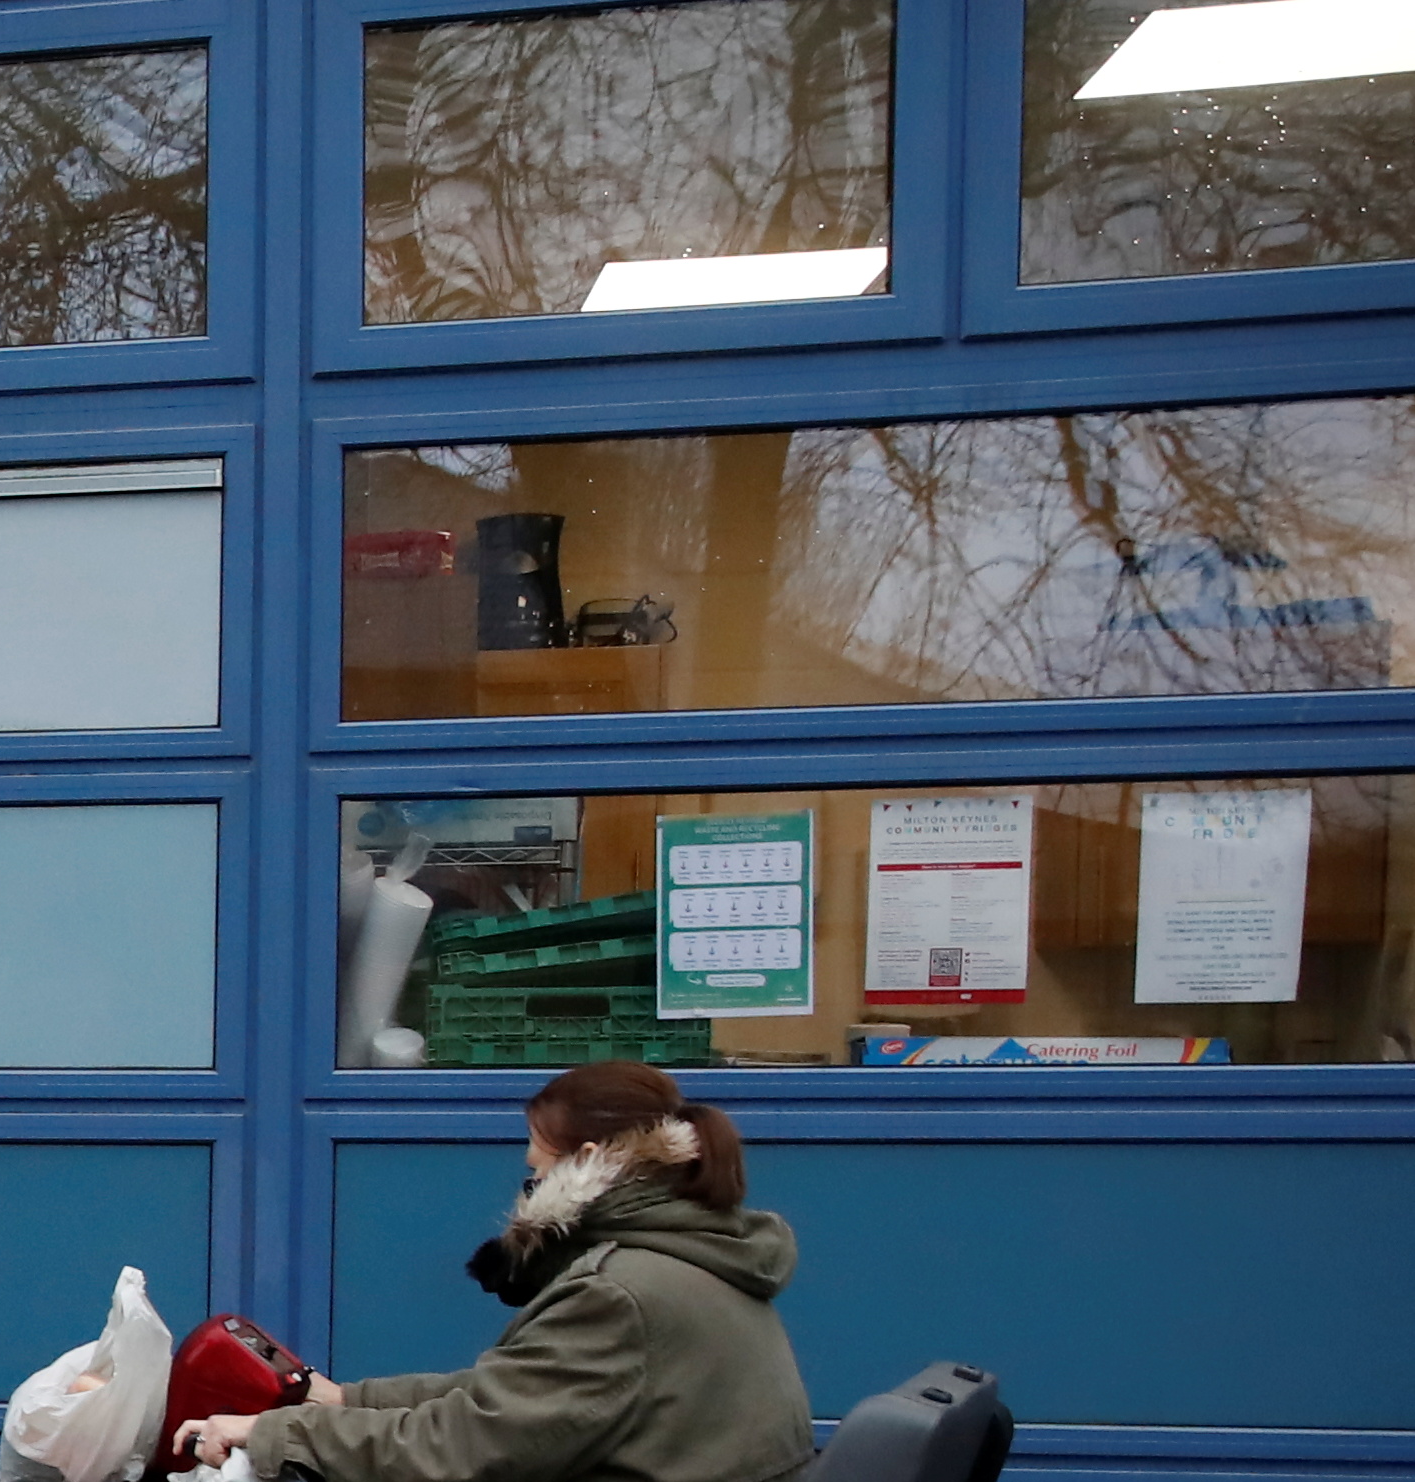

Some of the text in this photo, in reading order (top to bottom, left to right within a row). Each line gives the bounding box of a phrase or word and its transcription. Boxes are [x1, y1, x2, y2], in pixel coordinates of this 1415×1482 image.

[904, 814, 998, 825] MILTON KEYNES
[1026, 1043, 1099, 1060] Catering
[1106, 1042, 1137, 1057] Foil
